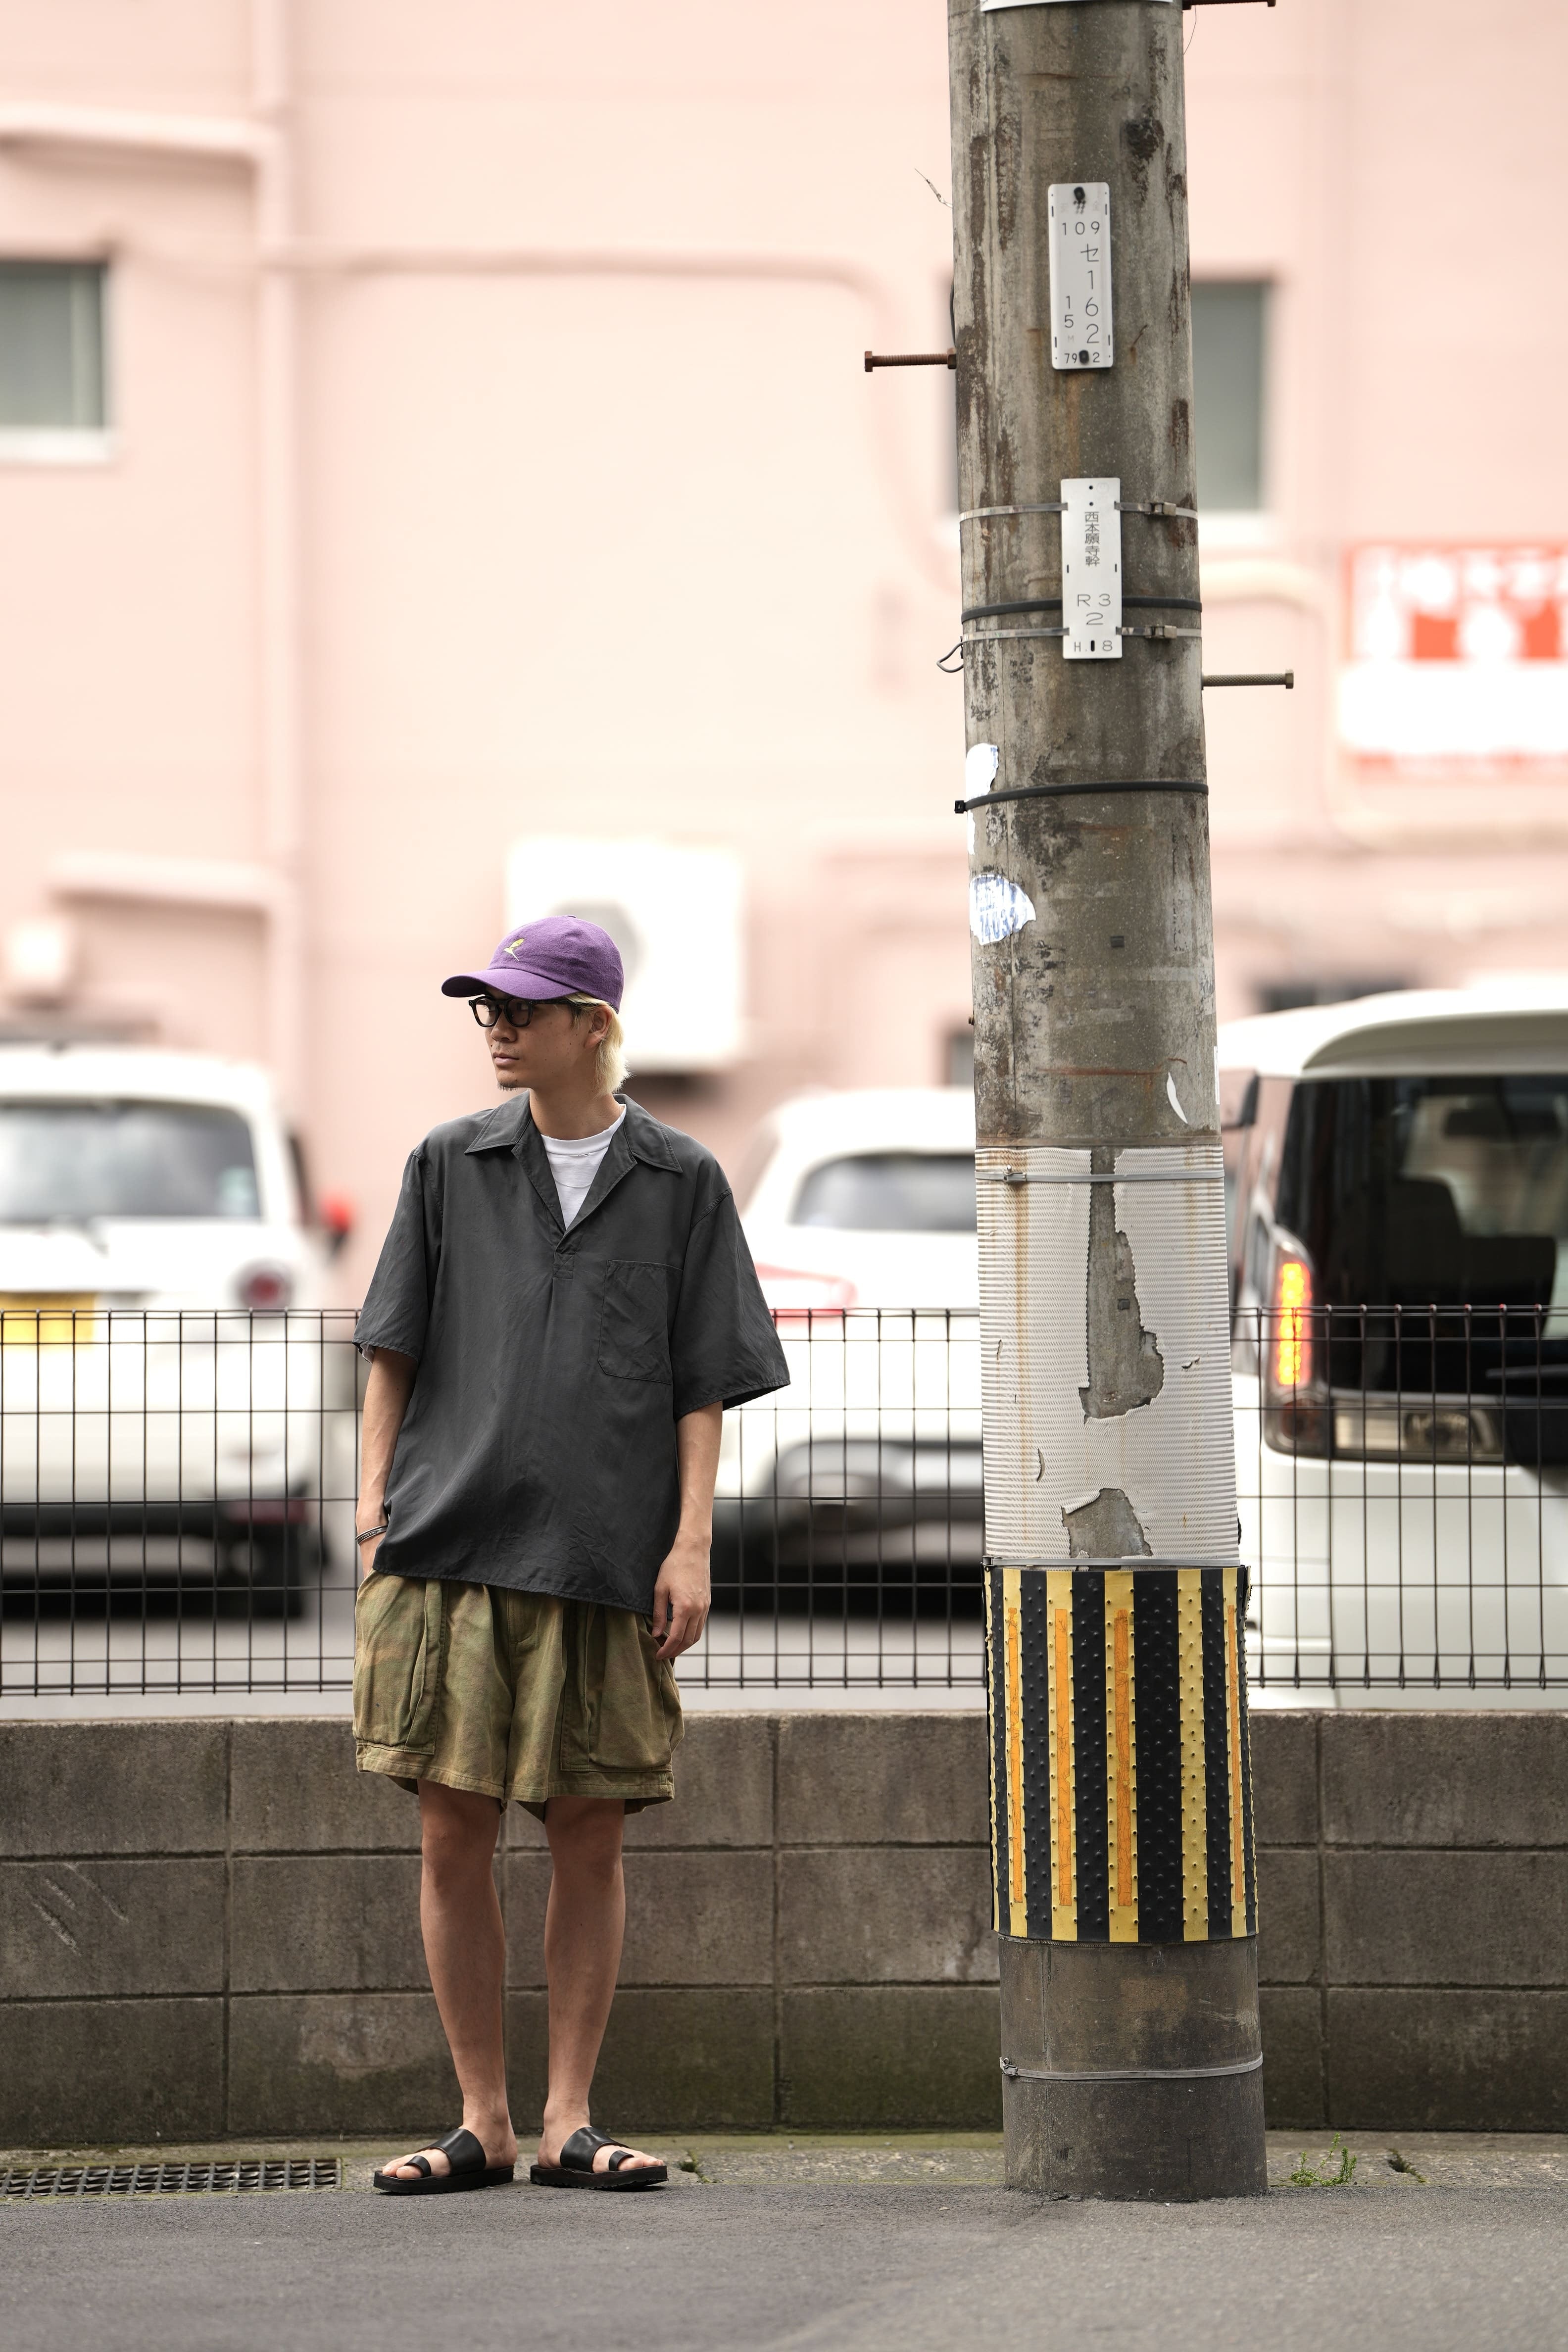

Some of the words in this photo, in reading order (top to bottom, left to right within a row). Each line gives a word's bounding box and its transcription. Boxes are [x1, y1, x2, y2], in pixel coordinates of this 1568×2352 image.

[1062, 221, 1100, 236] 109
[1084, 511, 1100, 567] 西本願寺幹
[1085, 612, 1104, 625] 2
